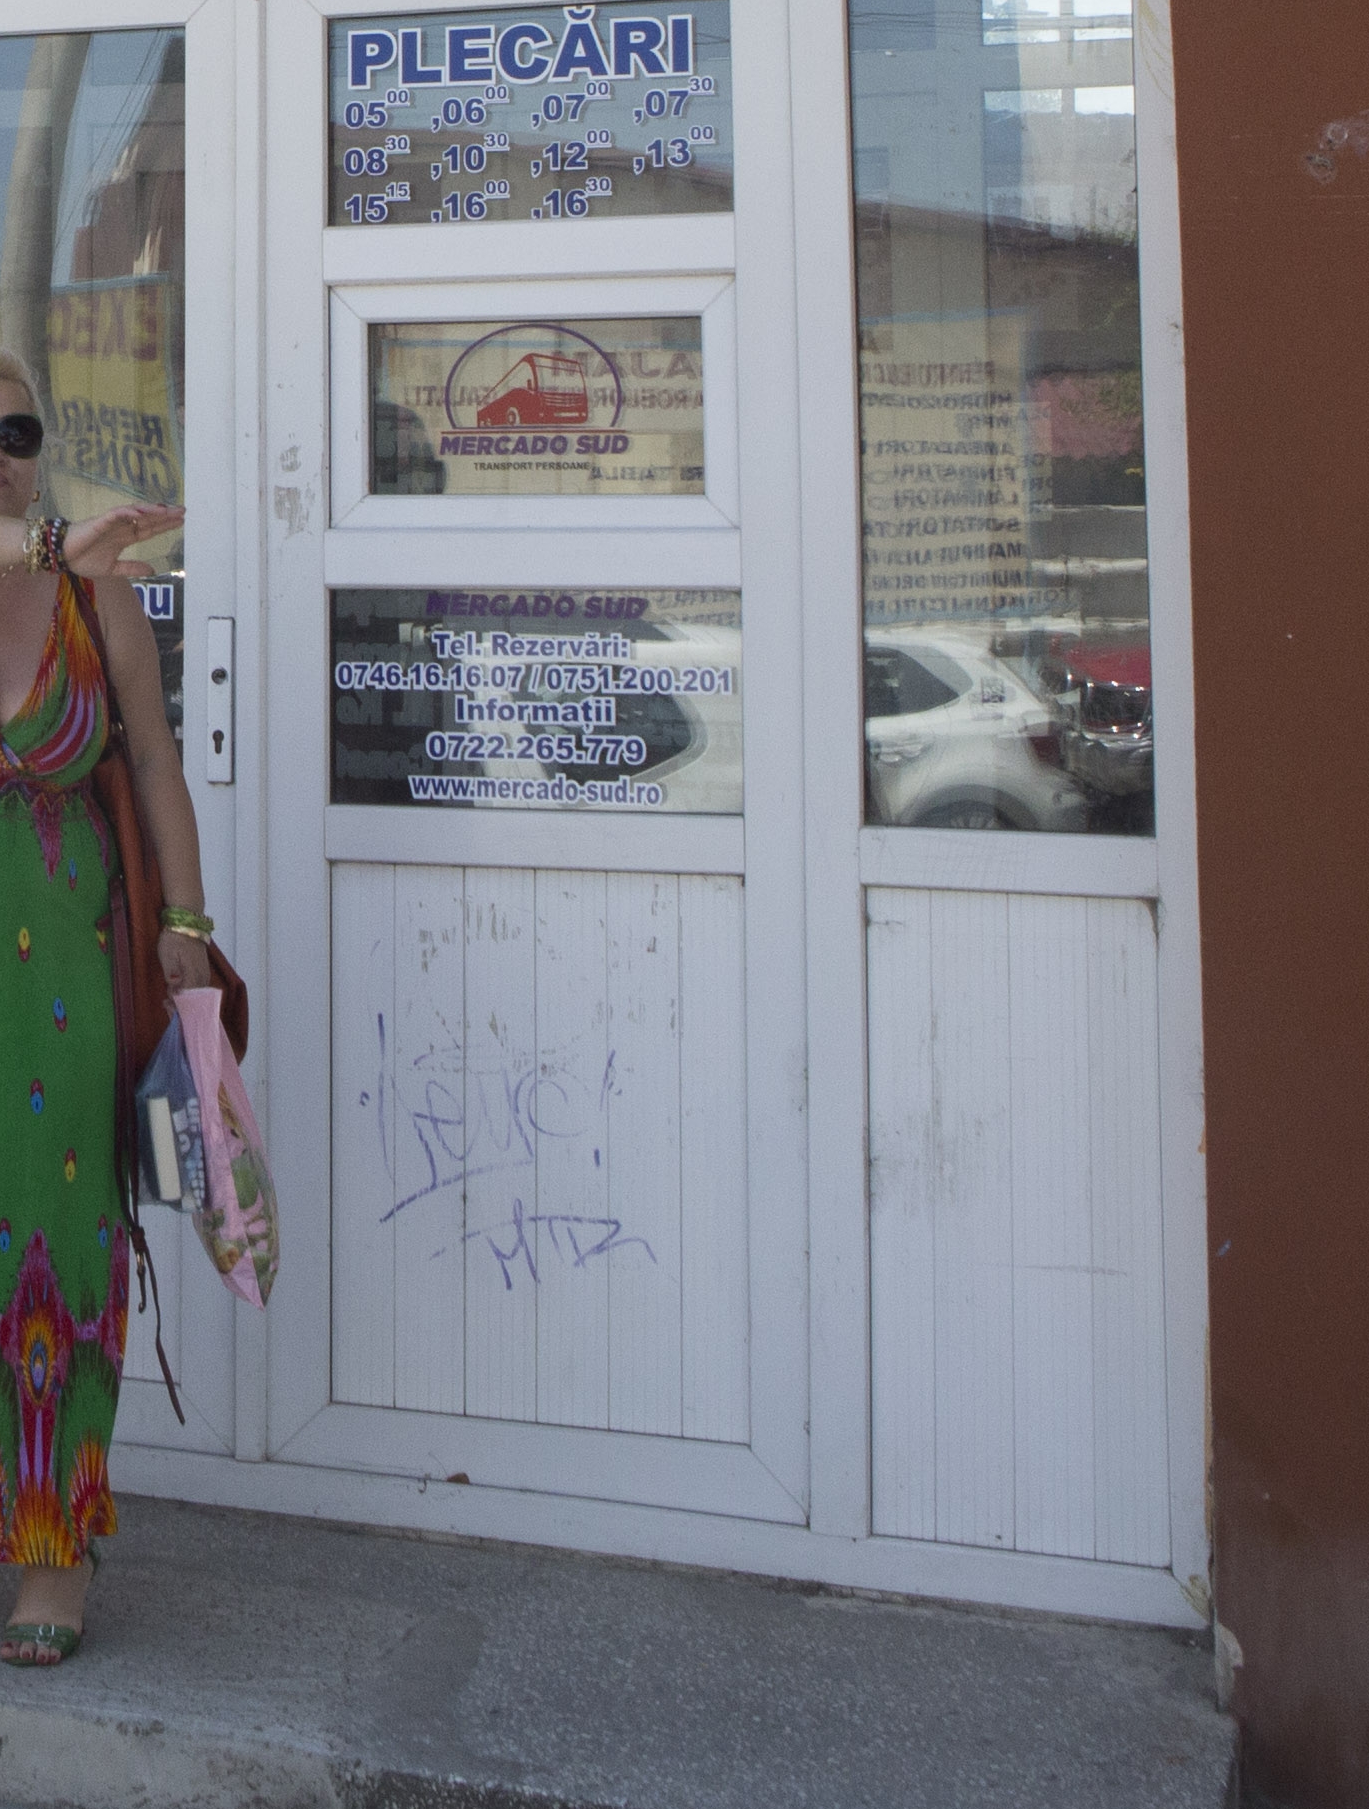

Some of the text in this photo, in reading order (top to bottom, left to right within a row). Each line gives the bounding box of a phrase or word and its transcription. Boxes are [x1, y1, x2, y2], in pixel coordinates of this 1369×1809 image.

[347, 5, 693, 90] PLECĂRI
[440, 434, 630, 456] MERCADO SUD
[474, 461, 591, 471] TRANSPORT PERSOANE
[426, 593, 577, 619] MERCADO
[584, 596, 649, 621] SUD
[431, 632, 631, 660] Tel. Rezervări:
[335, 661, 524, 692] 0746.16.16.07
[544, 665, 732, 695] 0751.200.201
[426, 734, 646, 765] 0722.265.779
[409, 773, 663, 805] www.mercado-sud.ro
